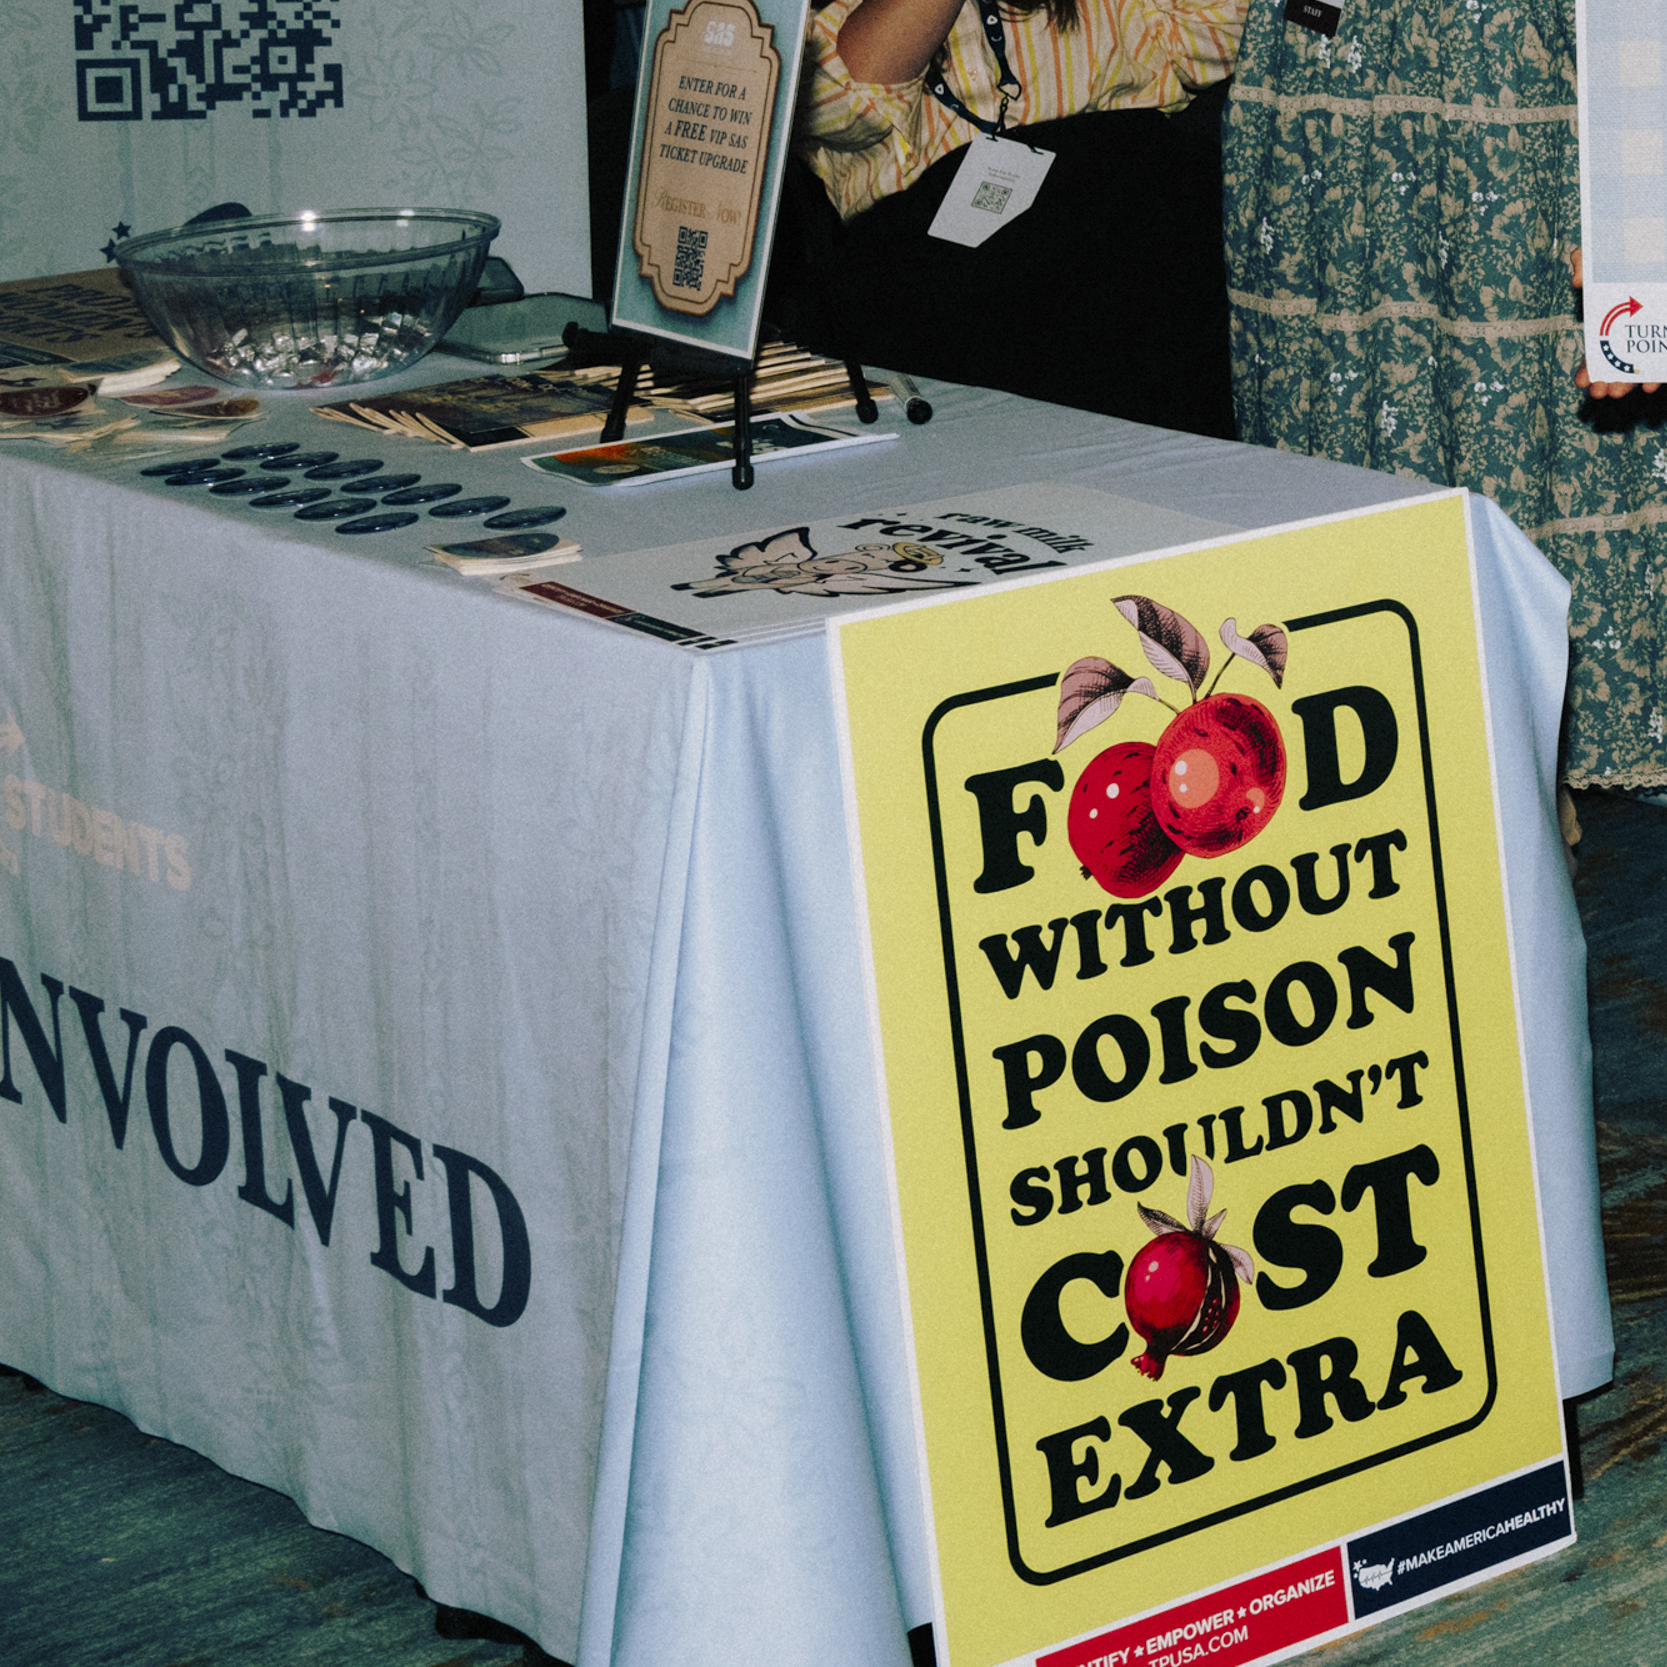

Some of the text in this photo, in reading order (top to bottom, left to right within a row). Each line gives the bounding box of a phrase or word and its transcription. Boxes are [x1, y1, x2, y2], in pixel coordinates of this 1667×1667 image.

[1303, 4, 1323, 19] STAFF
[667, 97, 753, 126] CHANCE TO WIN
[677, 75, 747, 101] ENTER FOR A
[658, 143, 749, 175] TICKET UPGRADE
[663, 120, 749, 150] A FREE VIP SAS
[836, 517, 1068, 576] revival
[936, 511, 1096, 555] raw milk
[2, 772, 192, 891] STUDENTS
[978, 829, 1408, 1000] WITHOUT
[992, 930, 1416, 1131] POISON
[0, 956, 532, 1328] NVOLVED
[1008, 1050, 1430, 1227] SHOULDN'T
[1020, 1144, 1441, 1383] CST
[1035, 1309, 1464, 1529] EXTRA
[1396, 1496, 1567, 1577] #MAKEAMERICAHEALTHY
[1146, 1608, 1235, 1657] EMPOWER
[1248, 1569, 1336, 1617] ORGANIZE
[1149, 1625, 1249, 1667] TPUSA.COM
